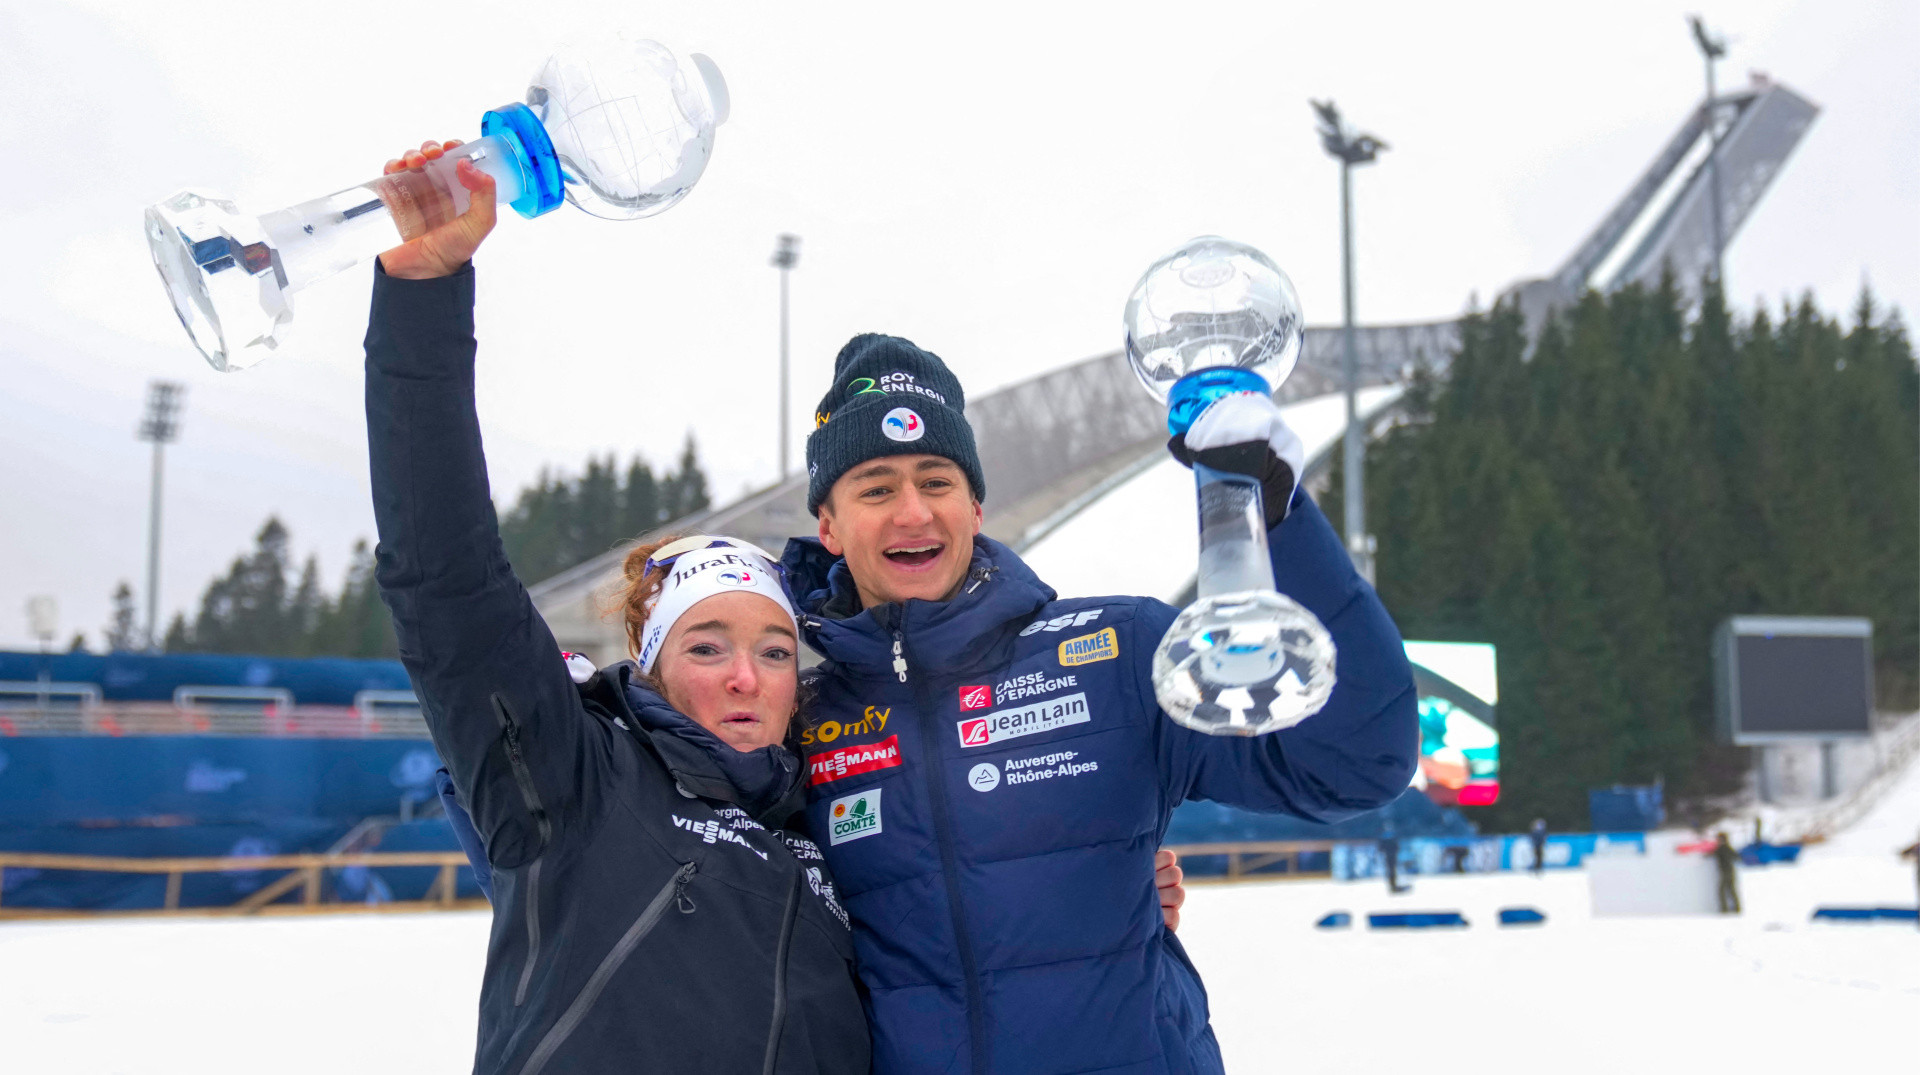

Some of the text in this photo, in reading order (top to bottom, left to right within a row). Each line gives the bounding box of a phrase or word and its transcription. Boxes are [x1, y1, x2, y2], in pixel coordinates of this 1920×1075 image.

[880, 372, 915, 385] ROY
[673, 554, 770, 591] JuraFl
[1065, 632, 1111, 656] ARMÉE
[1066, 649, 1113, 664] DE CHAMPIONS
[995, 671, 1045, 695] CAISSE
[996, 675, 1078, 706] D'EPARGNE
[801, 705, 891, 745] somfy
[1005, 751, 1079, 772] Auvergne-
[1006, 761, 1098, 786] Rhône-Alpes
[672, 814, 768, 861] VIESSMA
[785, 838, 820, 852] CAISS
